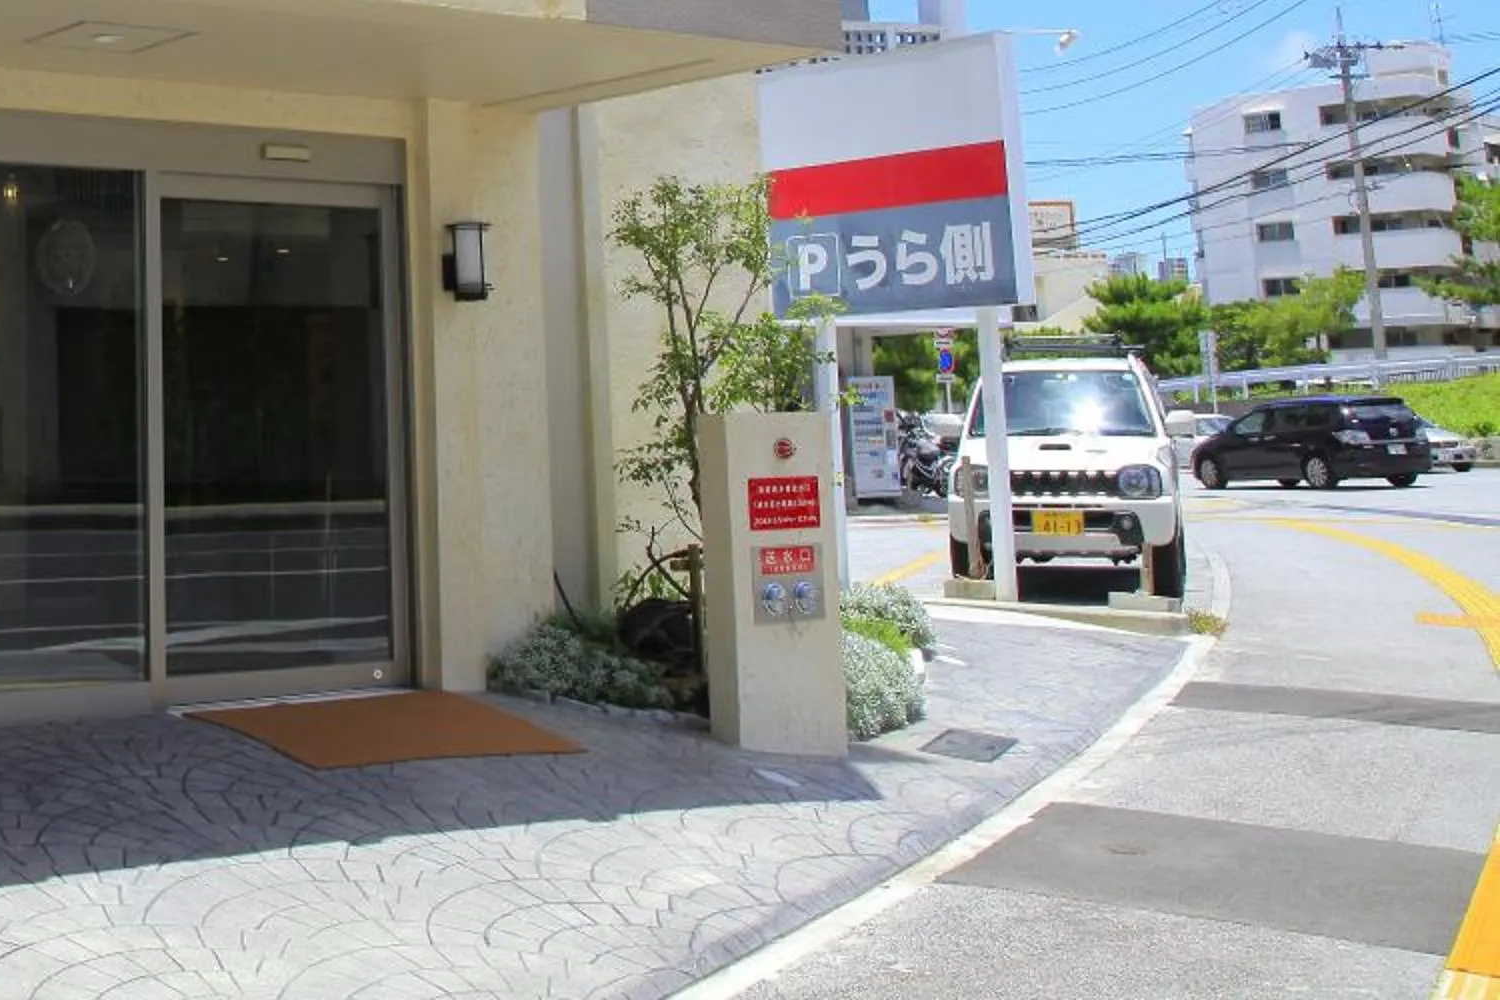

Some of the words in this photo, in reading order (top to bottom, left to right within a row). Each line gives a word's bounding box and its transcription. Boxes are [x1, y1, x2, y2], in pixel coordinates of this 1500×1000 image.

[797, 243, 828, 291] P
[846, 221, 996, 292] うら側
